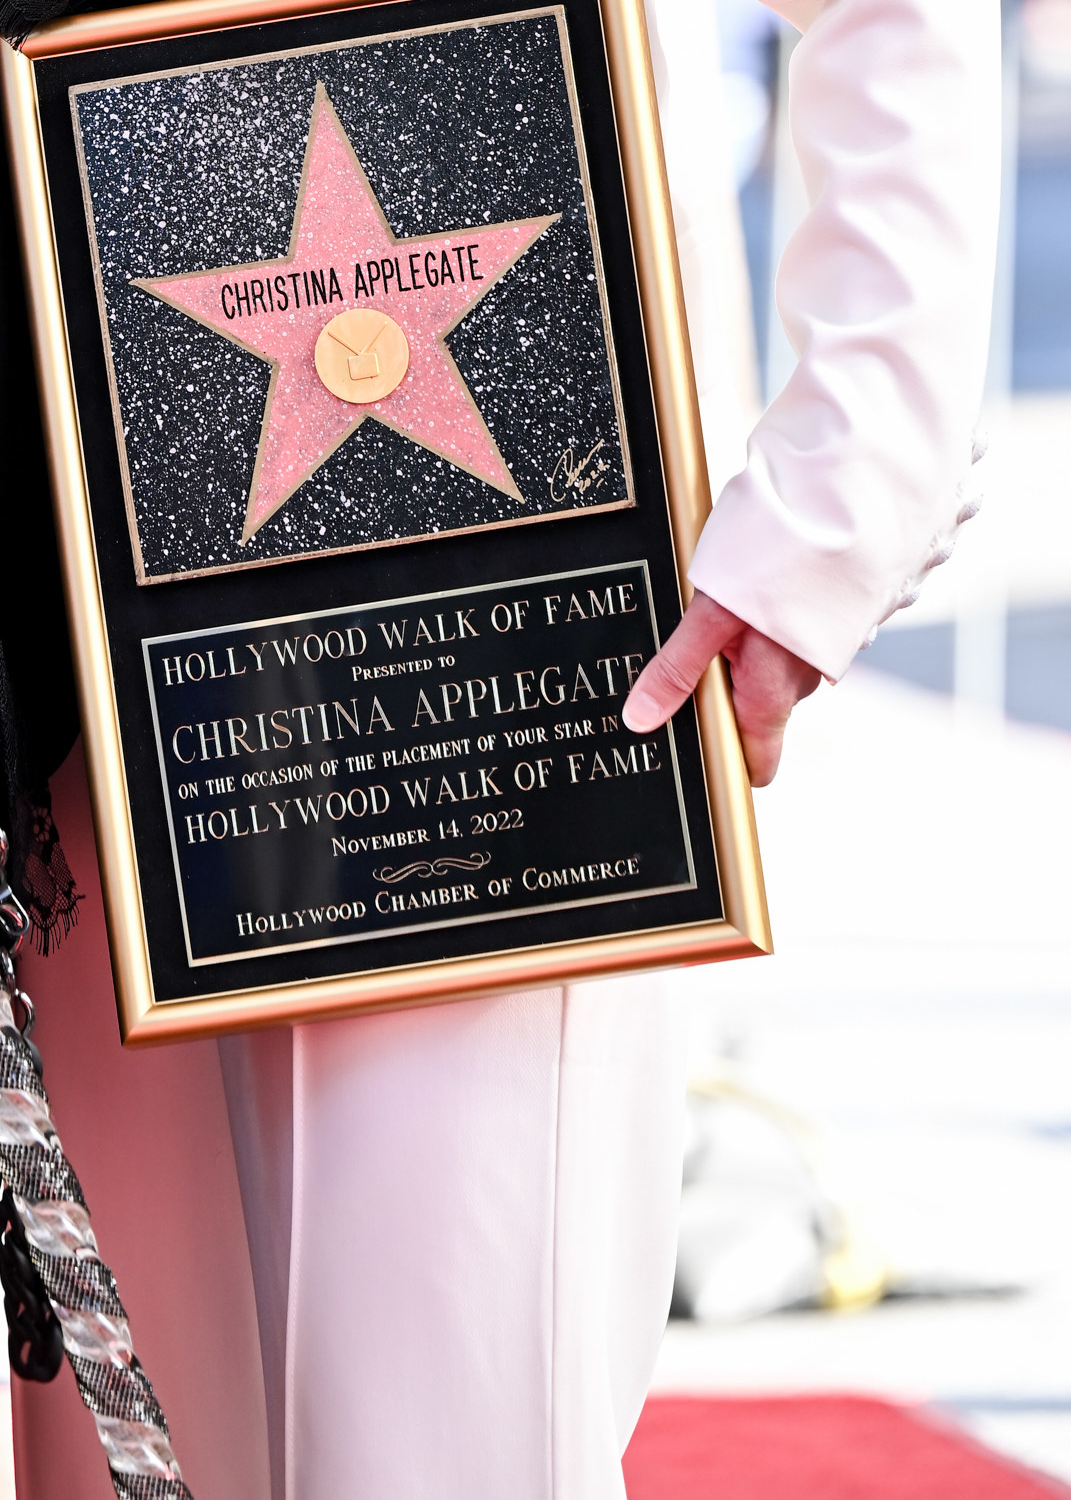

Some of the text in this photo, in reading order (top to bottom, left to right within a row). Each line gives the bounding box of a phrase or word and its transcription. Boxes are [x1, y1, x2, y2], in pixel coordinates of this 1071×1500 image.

[221, 244, 484, 320] CHRISTINA APPLEGATE
[162, 583, 638, 686] HOLLYWOOD WALK OF FAME
[172, 653, 643, 764] CHRISTINA APPLEGATE
[177, 715, 619, 800] ON THE OCCASION OF THE PLACEMENT OF YOUR STAR IN
[185, 741, 662, 845] HOLLYWOOD WALK OF FAME
[469, 808, 525, 835] 2022
